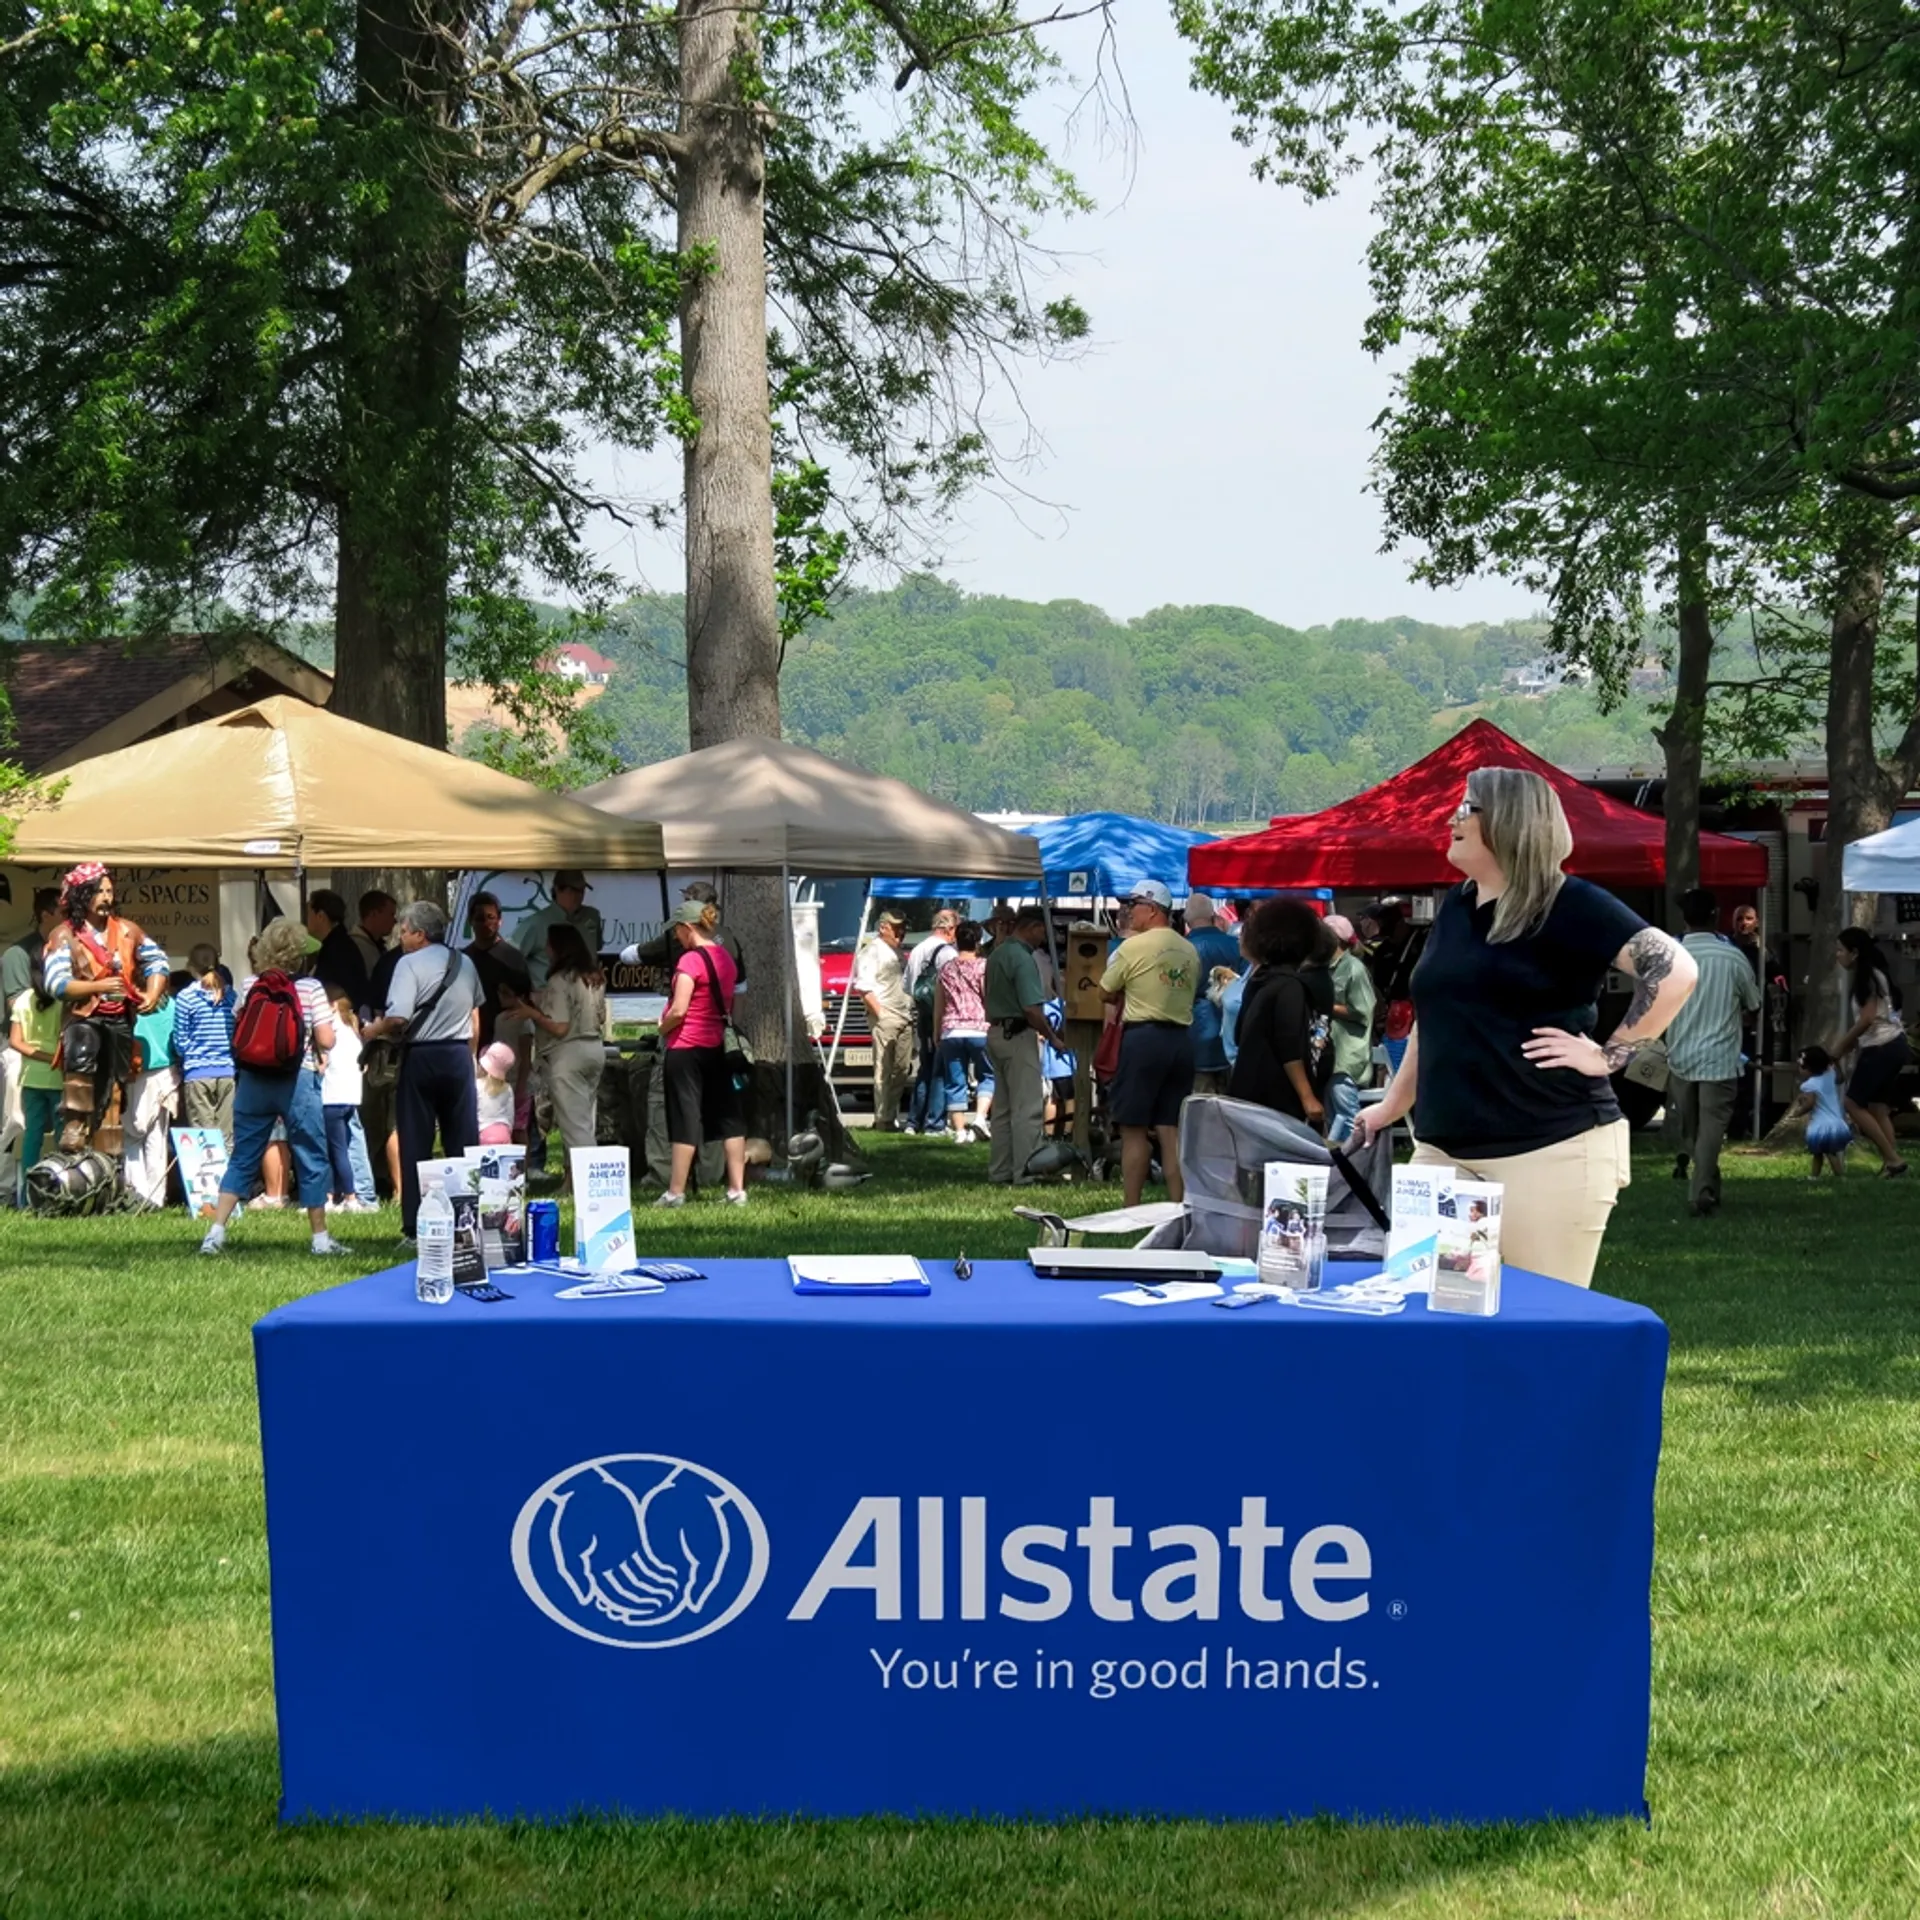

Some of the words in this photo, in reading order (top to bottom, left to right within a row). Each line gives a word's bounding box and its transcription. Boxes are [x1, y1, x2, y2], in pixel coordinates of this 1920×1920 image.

[138, 883, 210, 905] SPACES
[601, 918, 662, 946] UNLIM
[611, 961, 657, 988] Conser
[588, 1161, 626, 1170] ALWAYS
[588, 1170, 626, 1179] AHEAD
[787, 1496, 1372, 1622] Allstate
[870, 1648, 1018, 1690] You're
[1036, 1648, 1073, 1689] in
[1089, 1646, 1207, 1699] good
[1226, 1646, 1379, 1690] hands.
